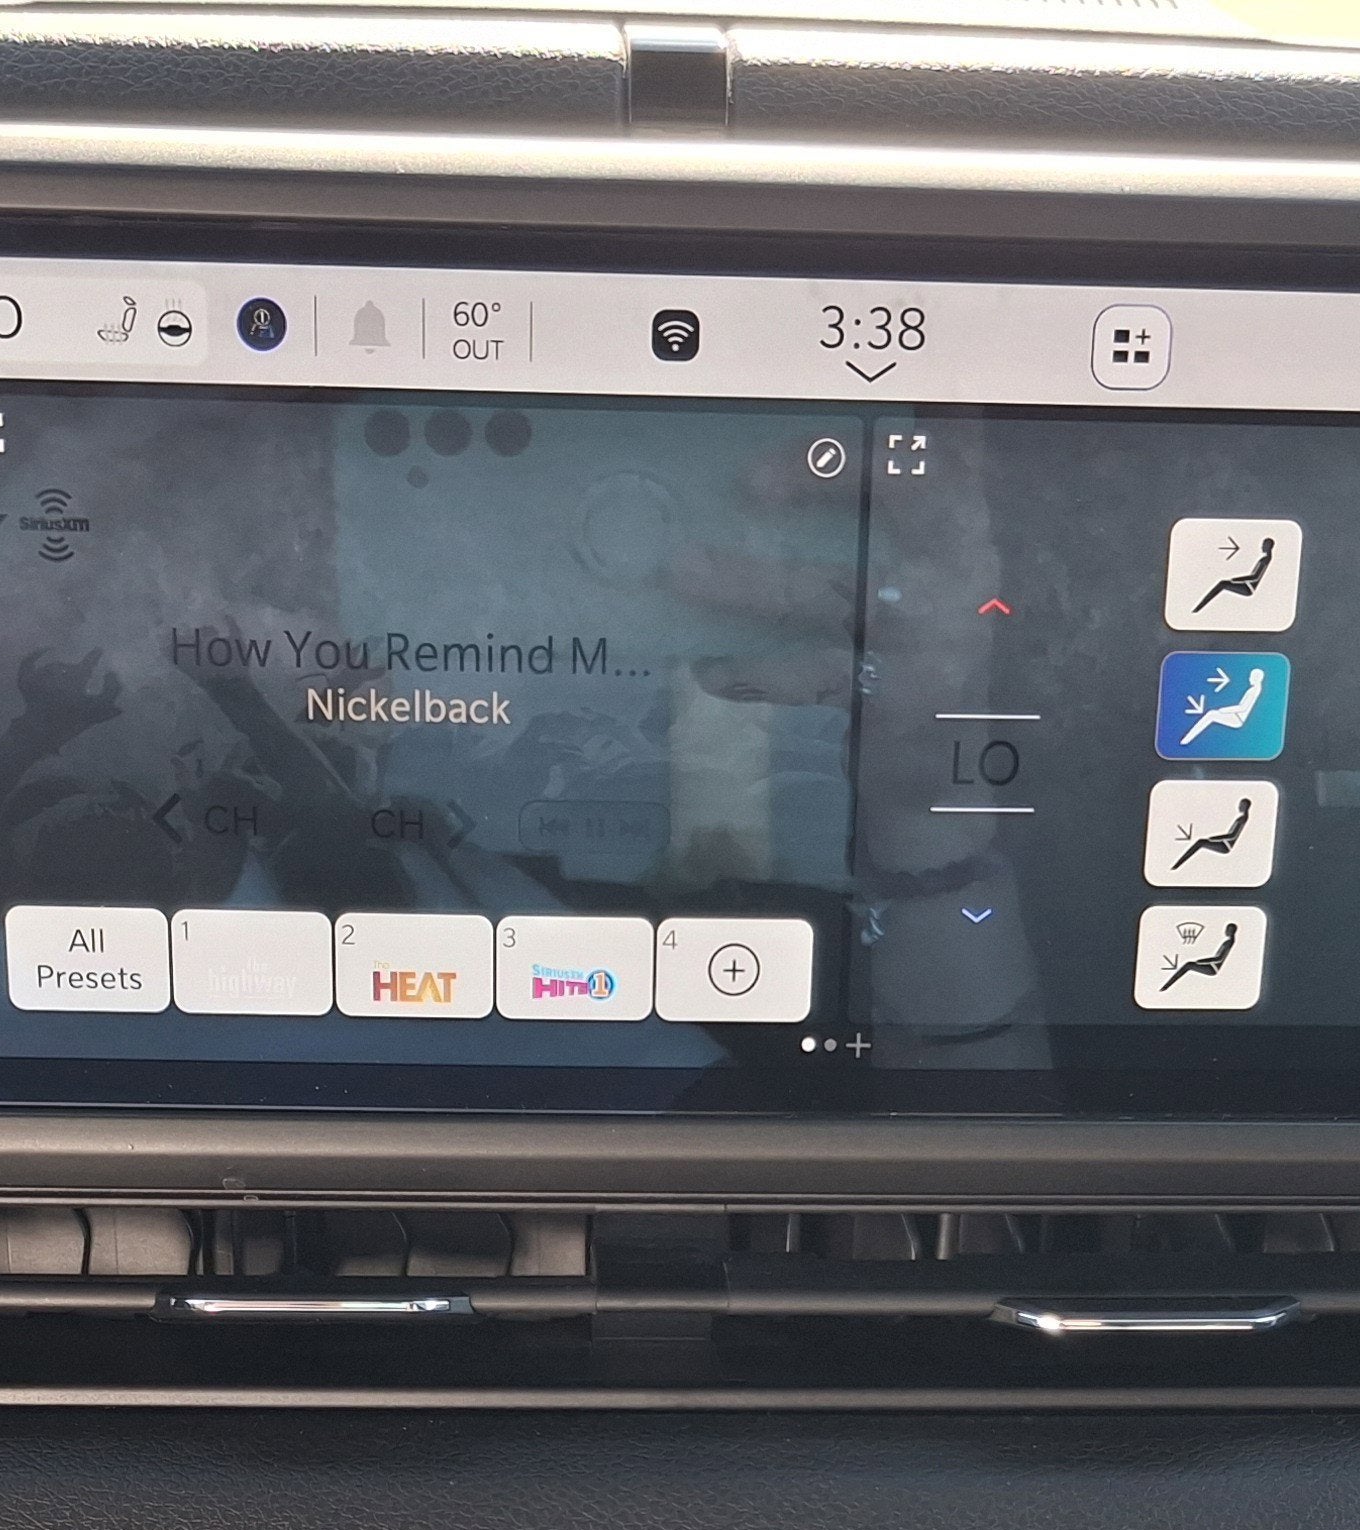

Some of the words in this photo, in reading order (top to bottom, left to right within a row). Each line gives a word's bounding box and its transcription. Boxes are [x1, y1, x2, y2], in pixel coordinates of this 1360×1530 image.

[452, 301, 502, 329] 60°
[819, 304, 927, 352] 3:38
[452, 338, 504, 362] OUT
[171, 626, 271, 668] How
[283, 630, 370, 671] You
[386, 632, 554, 675] Remind
[305, 688, 511, 725] Nickelback
[951, 738, 1021, 791] LO
[203, 804, 259, 836] CH
[370, 809, 425, 841] CH
[68, 929, 106, 954] All
[180, 920, 189, 941] 1
[341, 924, 356, 945] 2
[502, 927, 517, 948] 3
[662, 930, 678, 950] 4
[37, 964, 143, 991] Presets
[372, 971, 457, 1003] HEAT
